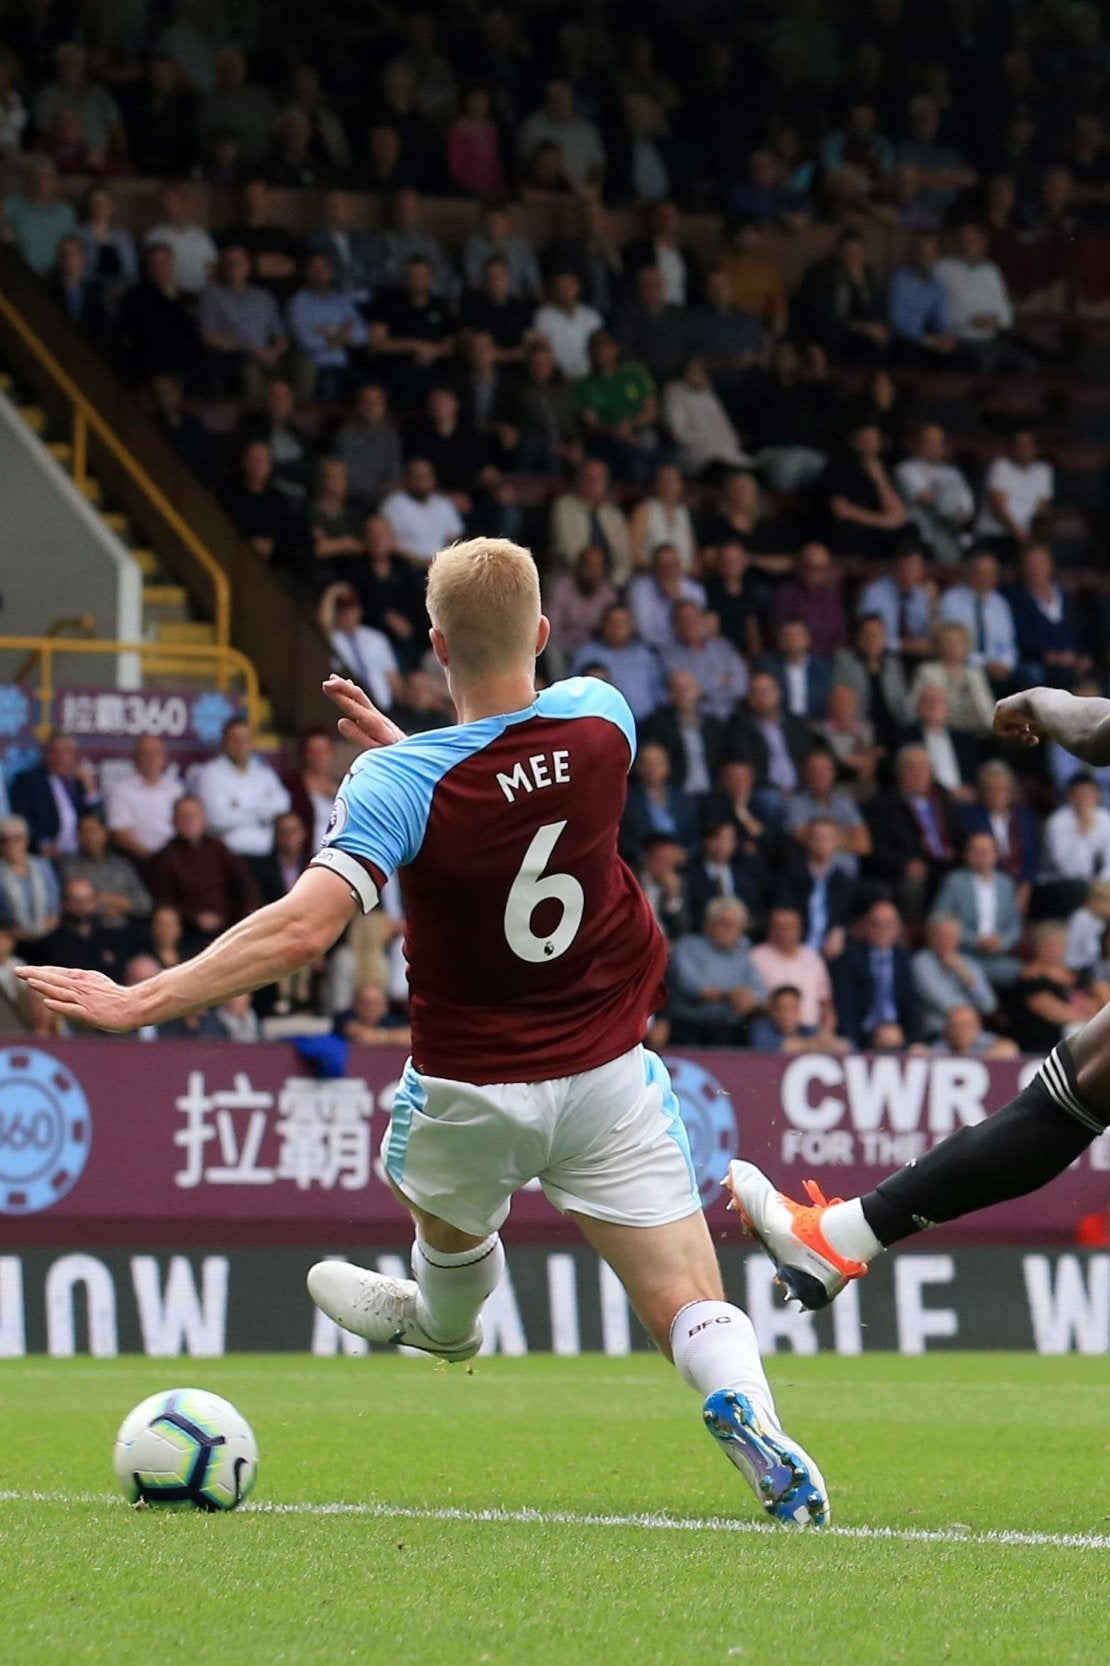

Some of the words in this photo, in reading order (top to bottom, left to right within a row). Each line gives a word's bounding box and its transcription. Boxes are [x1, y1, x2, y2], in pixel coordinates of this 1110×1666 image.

[496, 750, 571, 803] MEE
[504, 820, 585, 963] 6
[781, 1052, 990, 1132] CWR
[781, 1128, 854, 1167] FOR
[688, 1315, 732, 1338] BFC
